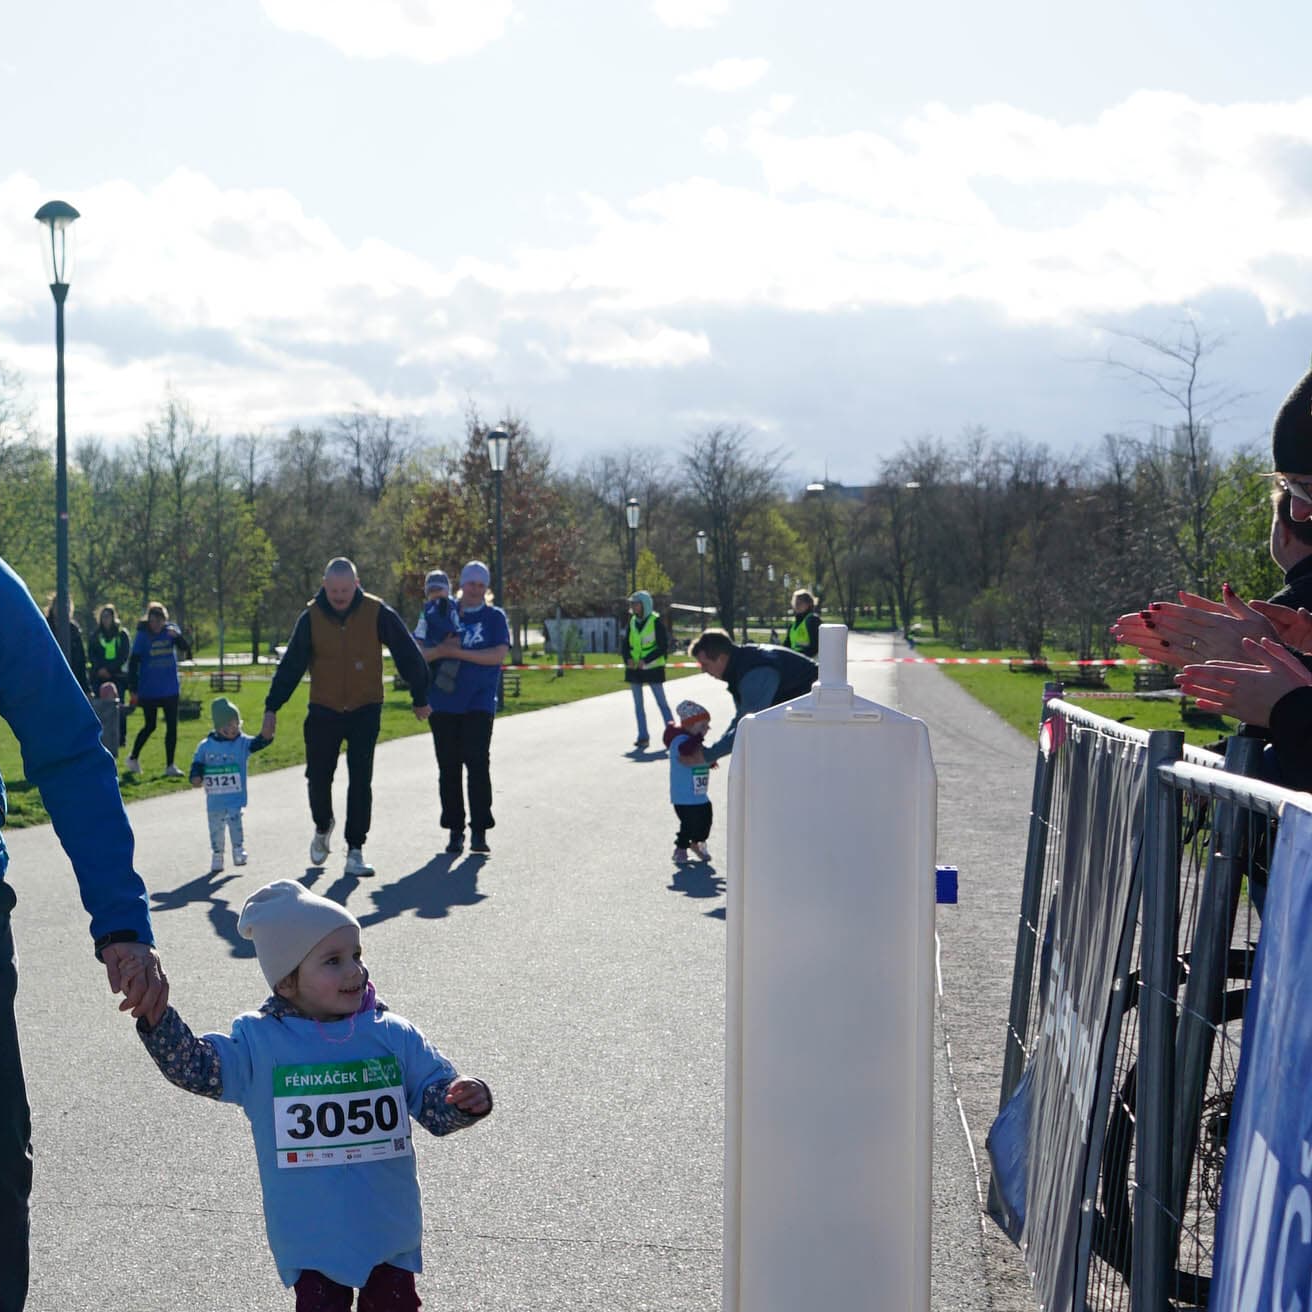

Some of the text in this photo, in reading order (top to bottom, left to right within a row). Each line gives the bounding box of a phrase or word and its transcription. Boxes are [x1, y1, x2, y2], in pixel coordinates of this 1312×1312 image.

[205, 775, 236, 787] 3121
[285, 1069, 358, 1087] FÉNIXÁČEK
[286, 1094, 399, 1140] 3050
